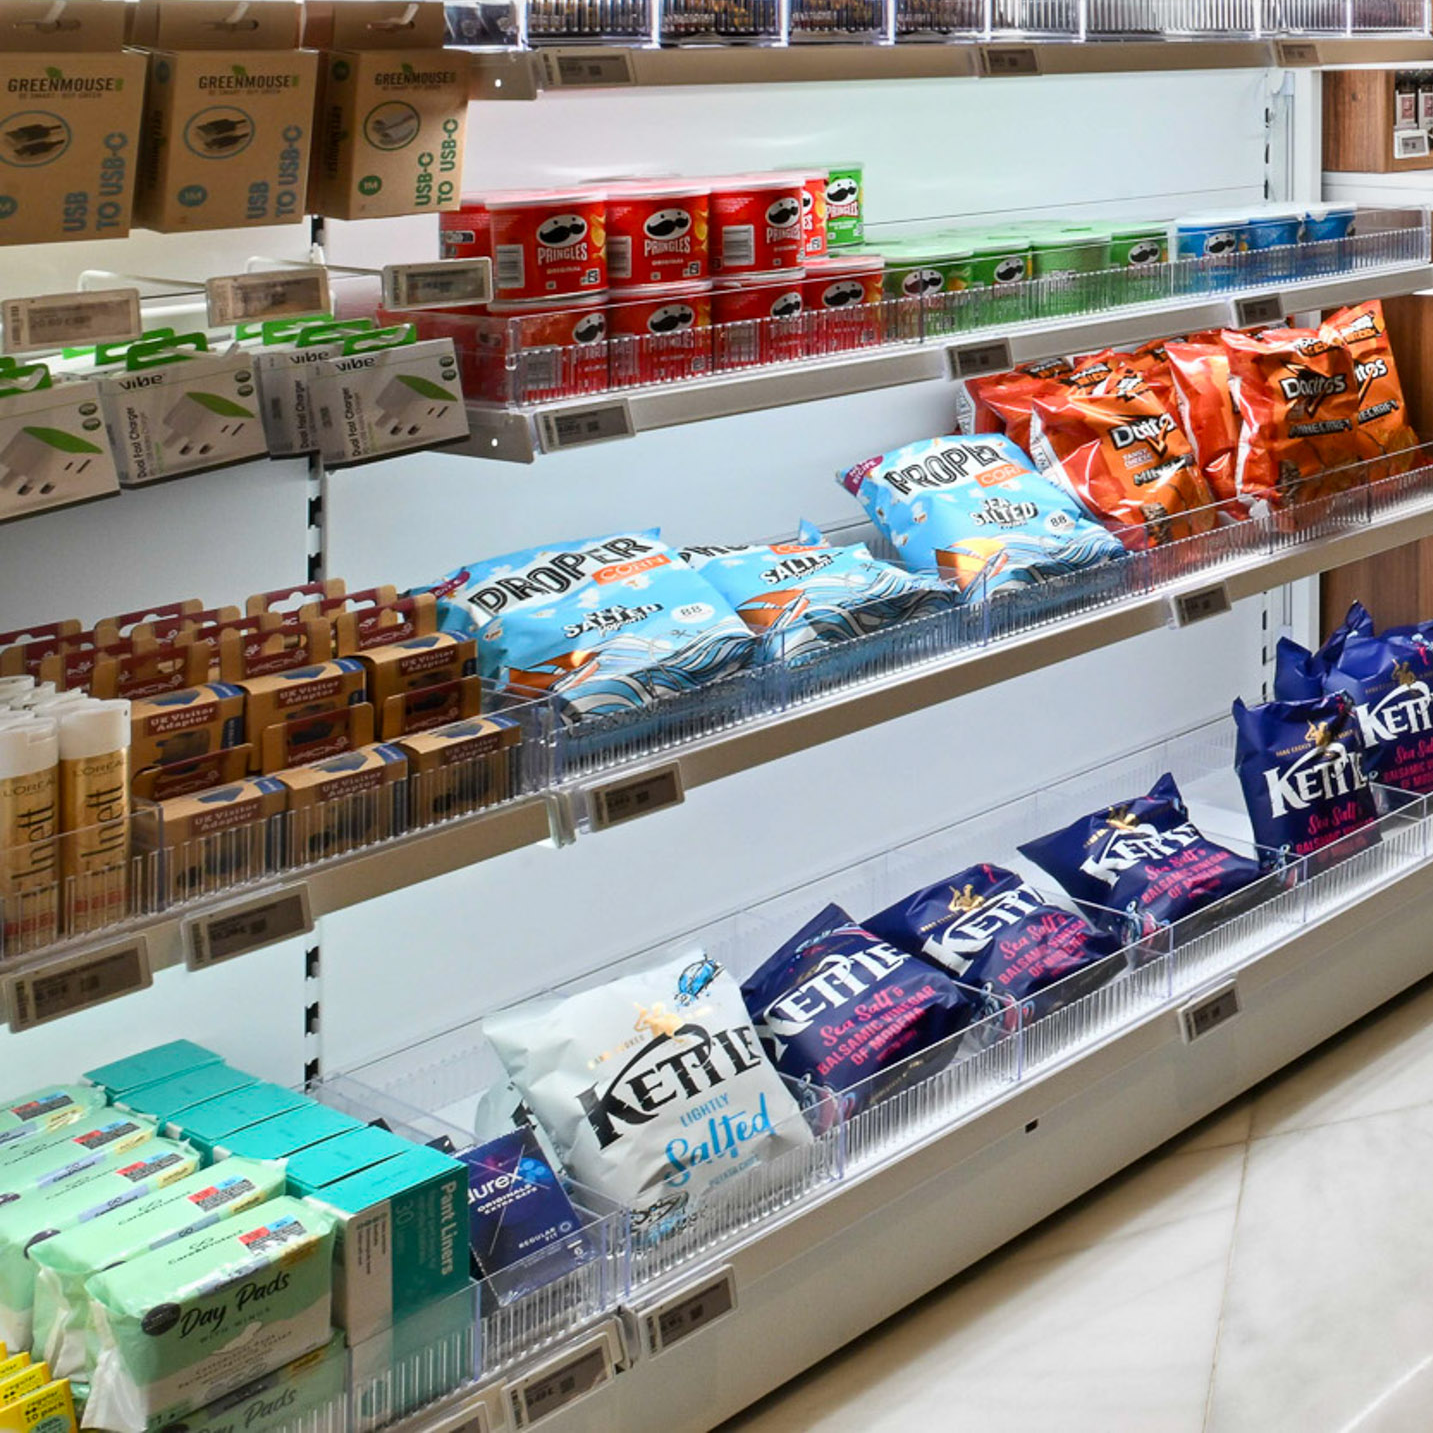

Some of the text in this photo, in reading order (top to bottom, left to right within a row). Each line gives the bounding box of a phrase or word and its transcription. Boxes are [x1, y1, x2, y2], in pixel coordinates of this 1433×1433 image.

[8, 78, 114, 92] GREENMOUSE
[199, 75, 291, 90] GREENMOUSE
[375, 71, 448, 86] GREENMOUSE
[275, 126, 302, 218] TO USB-C
[437, 119, 458, 205] TO USB-C
[96, 132, 128, 231] TO USB-C
[414, 152, 434, 207] USB-C
[247, 181, 269, 219] USB
[825, 203, 859, 219] PRINGLES
[63, 191, 89, 232] USB
[537, 244, 588, 264] PRINGLES
[643, 236, 691, 257] PRINGLES
[289, 351, 330, 365] vibe
[335, 356, 375, 372] vibe
[119, 374, 163, 391] vibe
[1283, 374, 1348, 399] Doritos
[970, 502, 1039, 526] SALTED
[982, 498, 1010, 509] SEA
[1050, 516, 1067, 527] 88
[468, 538, 653, 616] PROPER
[600, 557, 664, 580] CORN
[679, 606, 701, 619] 88
[419, 648, 456, 664] Visitor
[285, 688, 335, 705] Adaptor
[297, 679, 341, 696] Visitor
[156, 715, 209, 733] Adaptor
[171, 706, 216, 723] Visitor
[1395, 745, 1416, 762] Sea
[340, 771, 383, 790] Visitor
[214, 804, 258, 823] Visitor
[1308, 802, 1356, 834] Sea Salt
[1144, 859, 1171, 881] Sea
[1000, 939, 1030, 961] Sea
[998, 943, 1050, 985] BALSAMIC
[819, 987, 894, 1048] Sea Salt
[816, 984, 937, 1075] BALSAMIC VINEGAR
[850, 1007, 926, 1066] OF MODENA
[576, 1024, 762, 1149] KETTLE
[680, 1092, 730, 1127] LIGHTLY
[664, 1091, 776, 1188] Salted
[477, 1184, 532, 1212] ORIGINALS
[484, 1187, 537, 1214] EXTRA SAFE
[438, 1179, 458, 1276] Pant Liners
[518, 1228, 556, 1248] REGULAR
[545, 1232, 558, 1241] FIT
[180, 1271, 291, 1339] Day Pads
[27, 1414, 38, 1423] 10
[244, 1388, 297, 1431] Pads
